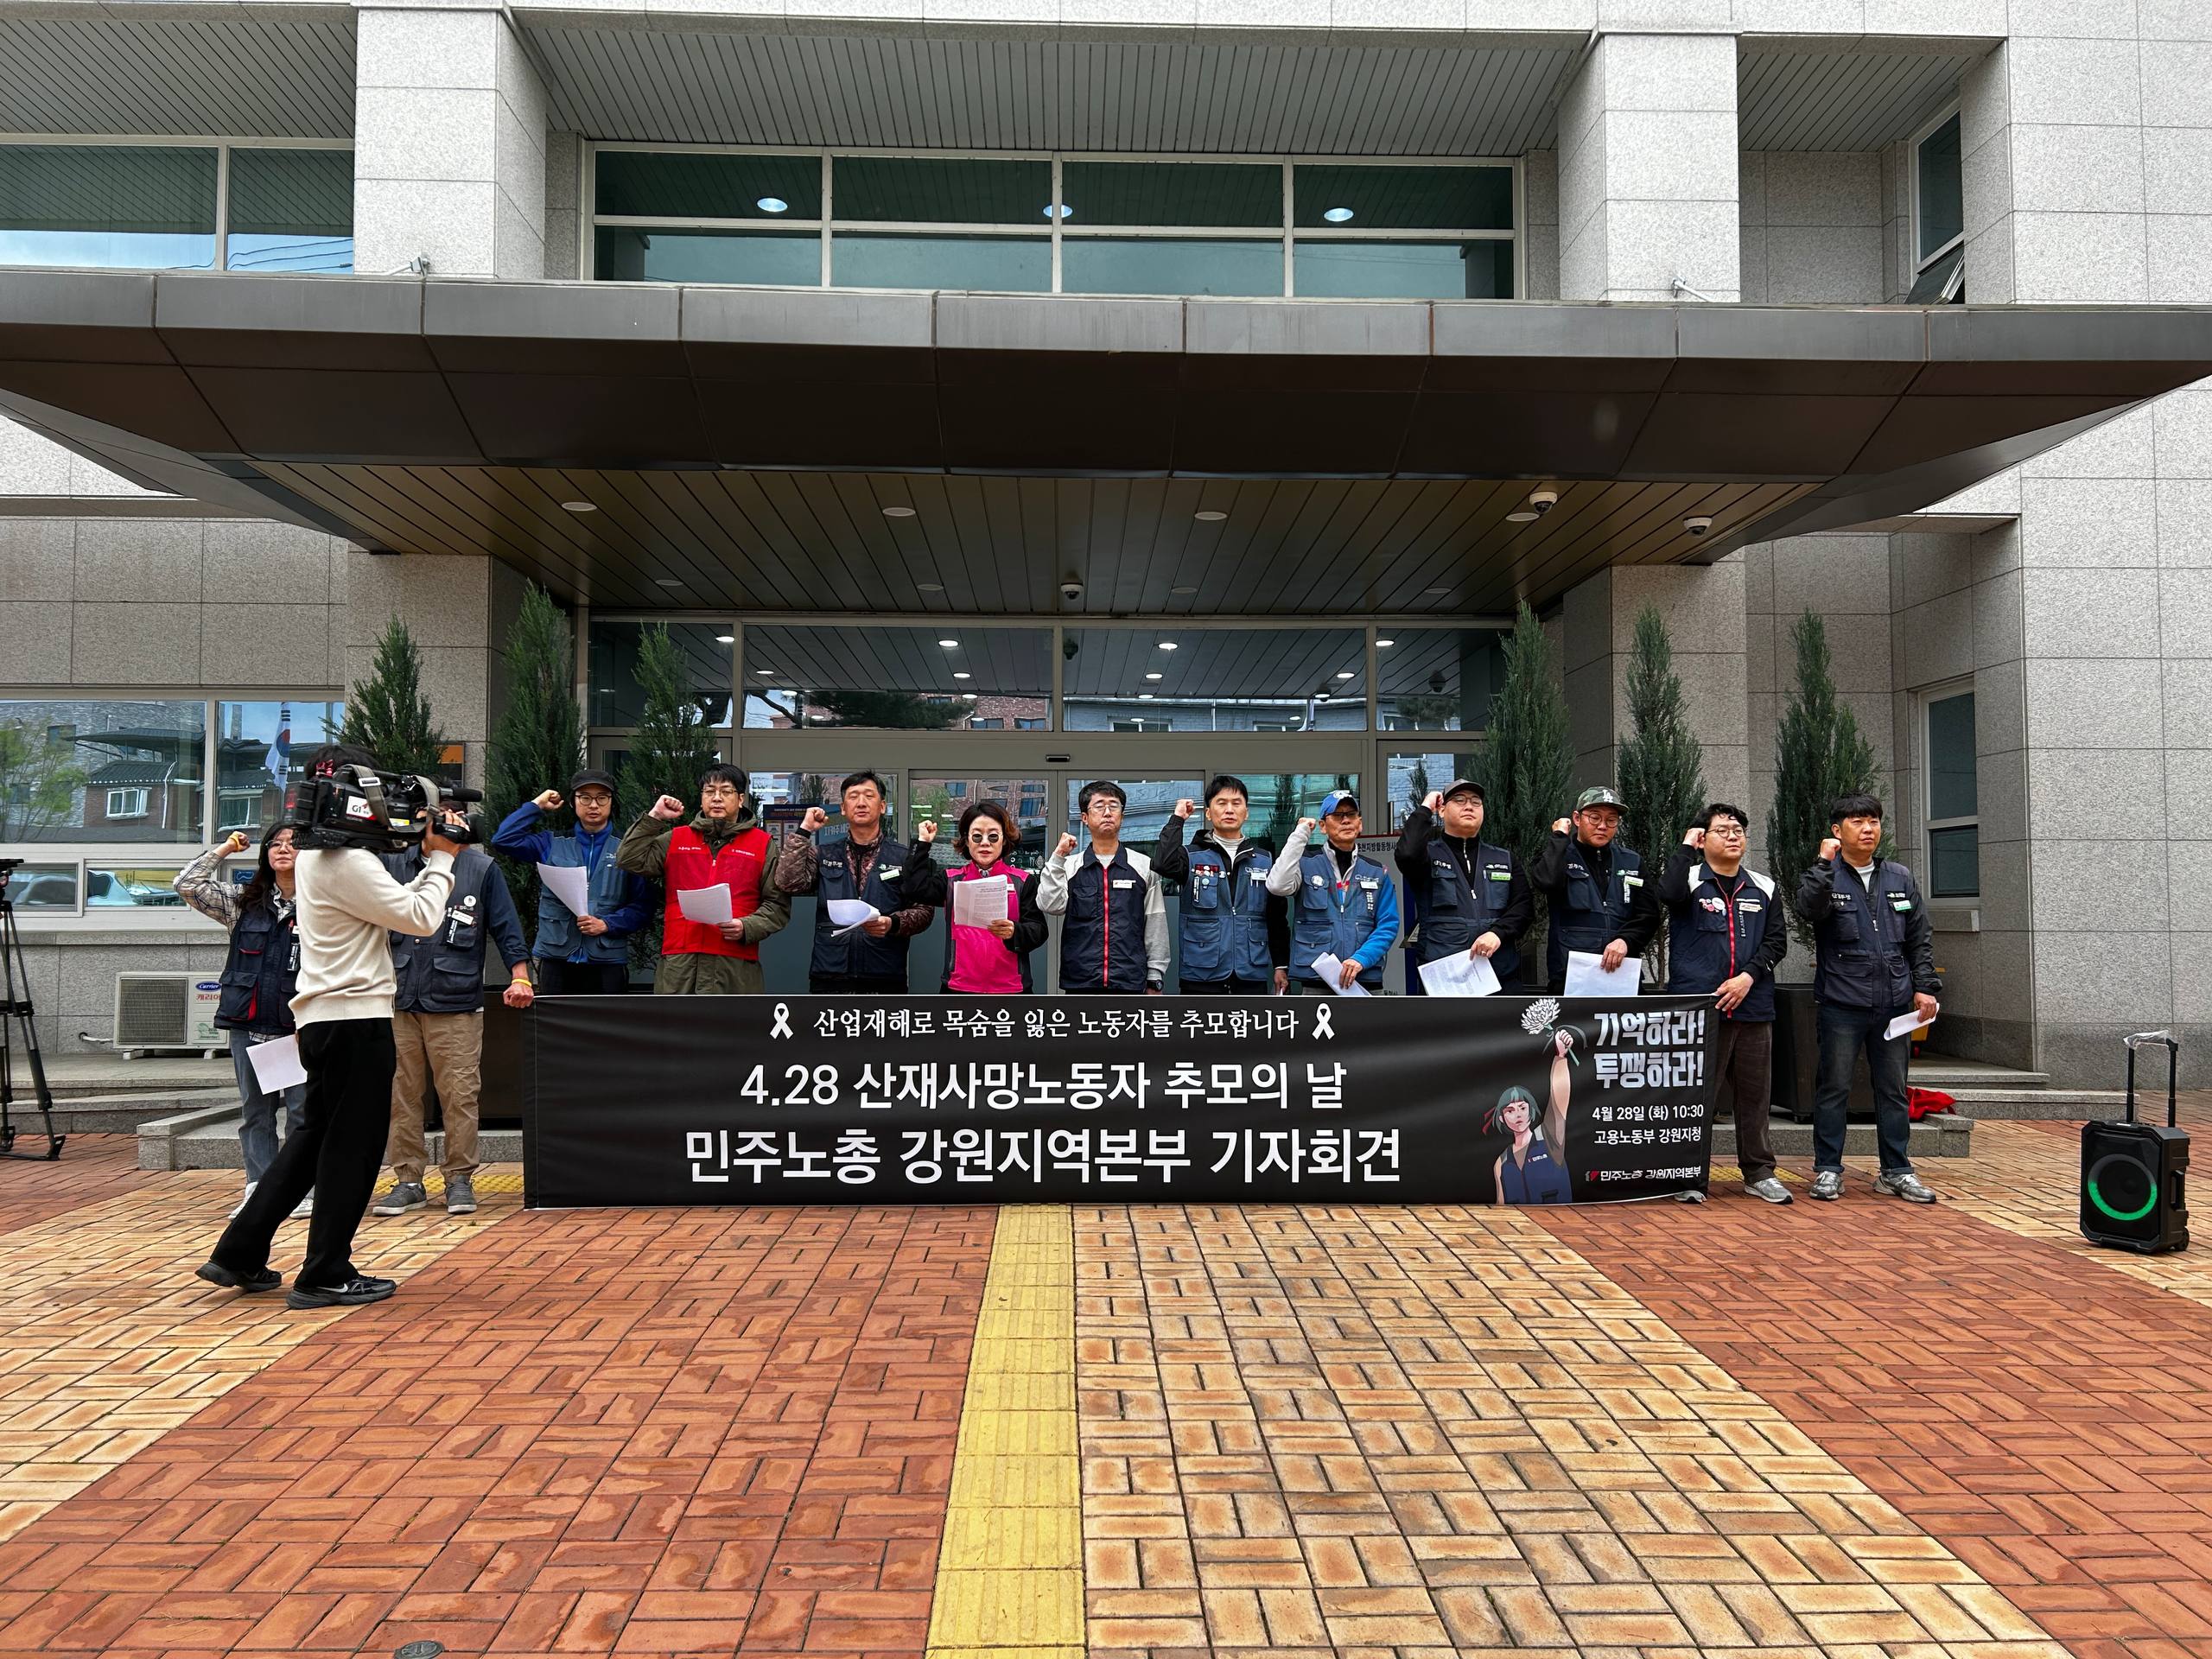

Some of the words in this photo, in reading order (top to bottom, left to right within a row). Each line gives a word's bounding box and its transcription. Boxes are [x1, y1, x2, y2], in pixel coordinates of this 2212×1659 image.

[814, 1009, 935, 1038] 산업재해로
[943, 1009, 1015, 1037] 목숨을
[1024, 1009, 1071, 1038] 잃은
[1078, 1009, 1173, 1038] 노동자를
[1180, 1010, 1299, 1039] 추모합니다
[1593, 1009, 1706, 1046] 기억하라!
[741, 1065, 838, 1106] 4.28
[853, 1063, 1150, 1109] 산재사망노동자
[1165, 1063, 1287, 1109] 추모의
[1306, 1063, 1347, 1109] 날
[1592, 1106, 1613, 1122] 4월
[1616, 1105, 1645, 1122] 28일
[1648, 1105, 1669, 1122] (화)
[1672, 1103, 1704, 1119] 10:30
[1593, 1128, 1656, 1146] 고용노동부
[1658, 1126, 1701, 1145] 강원지청
[687, 1129, 880, 1185] 민주노총
[899, 1128, 1192, 1185] 강원지역본부
[1211, 1128, 1400, 1184] 기자회견
[1600, 1170, 1643, 1181] 민주노총
[1645, 1166, 1701, 1179] 강원지역본부
